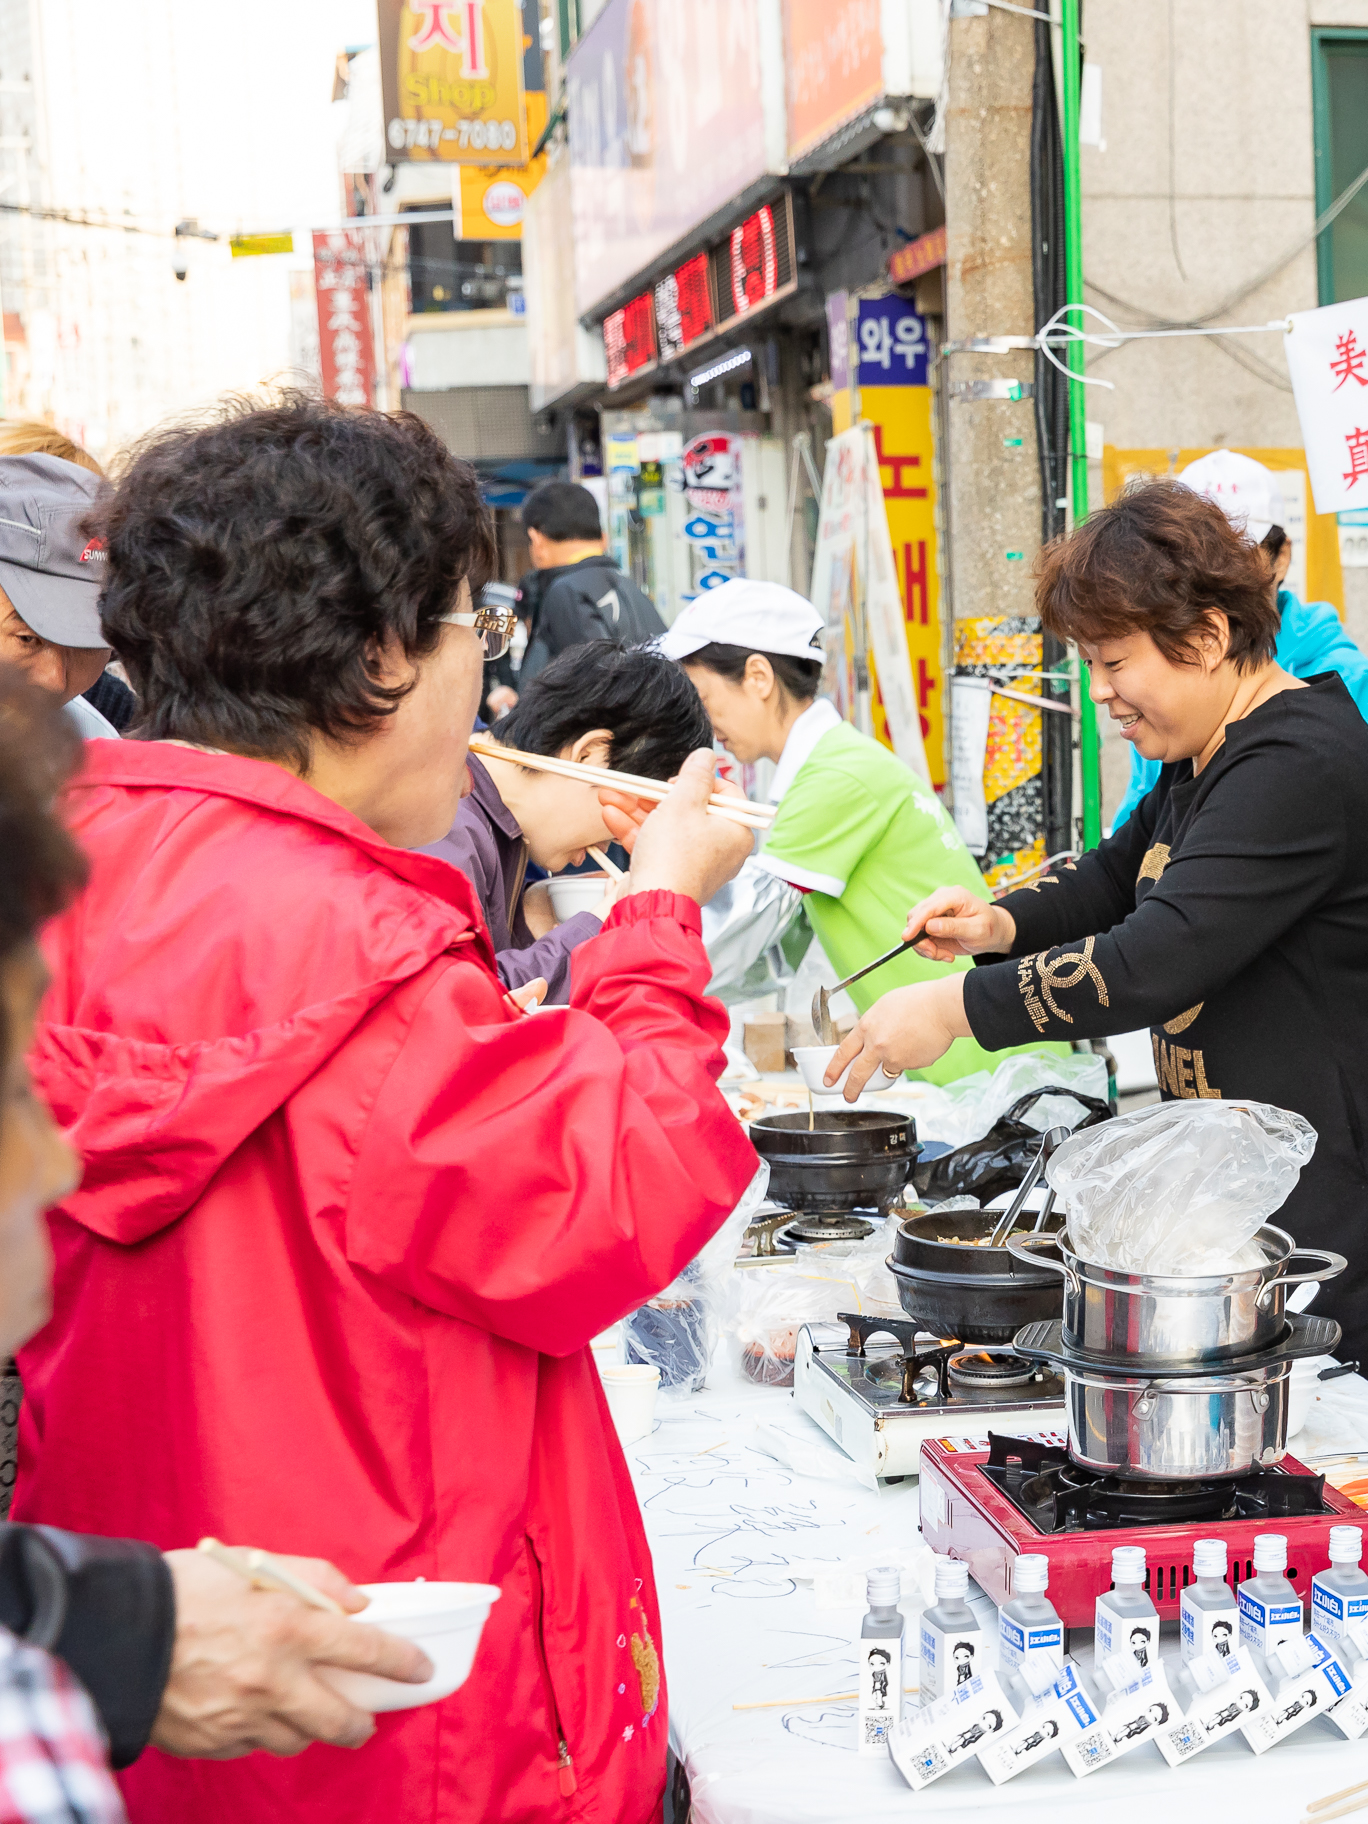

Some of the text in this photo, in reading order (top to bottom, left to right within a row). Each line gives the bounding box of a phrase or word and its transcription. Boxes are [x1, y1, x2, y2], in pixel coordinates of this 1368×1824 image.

[406, 75, 495, 112] Shop
[860, 315, 926, 370] 와우
[1238, 1594, 1264, 1624] 江小白
[1270, 1611, 1300, 1622] 江小白
[1313, 1587, 1342, 1616] 江小白
[1030, 1632, 1060, 1646] 江小白
[1326, 1664, 1346, 1694] 江小白
[1069, 1696, 1090, 1727] 江小白
